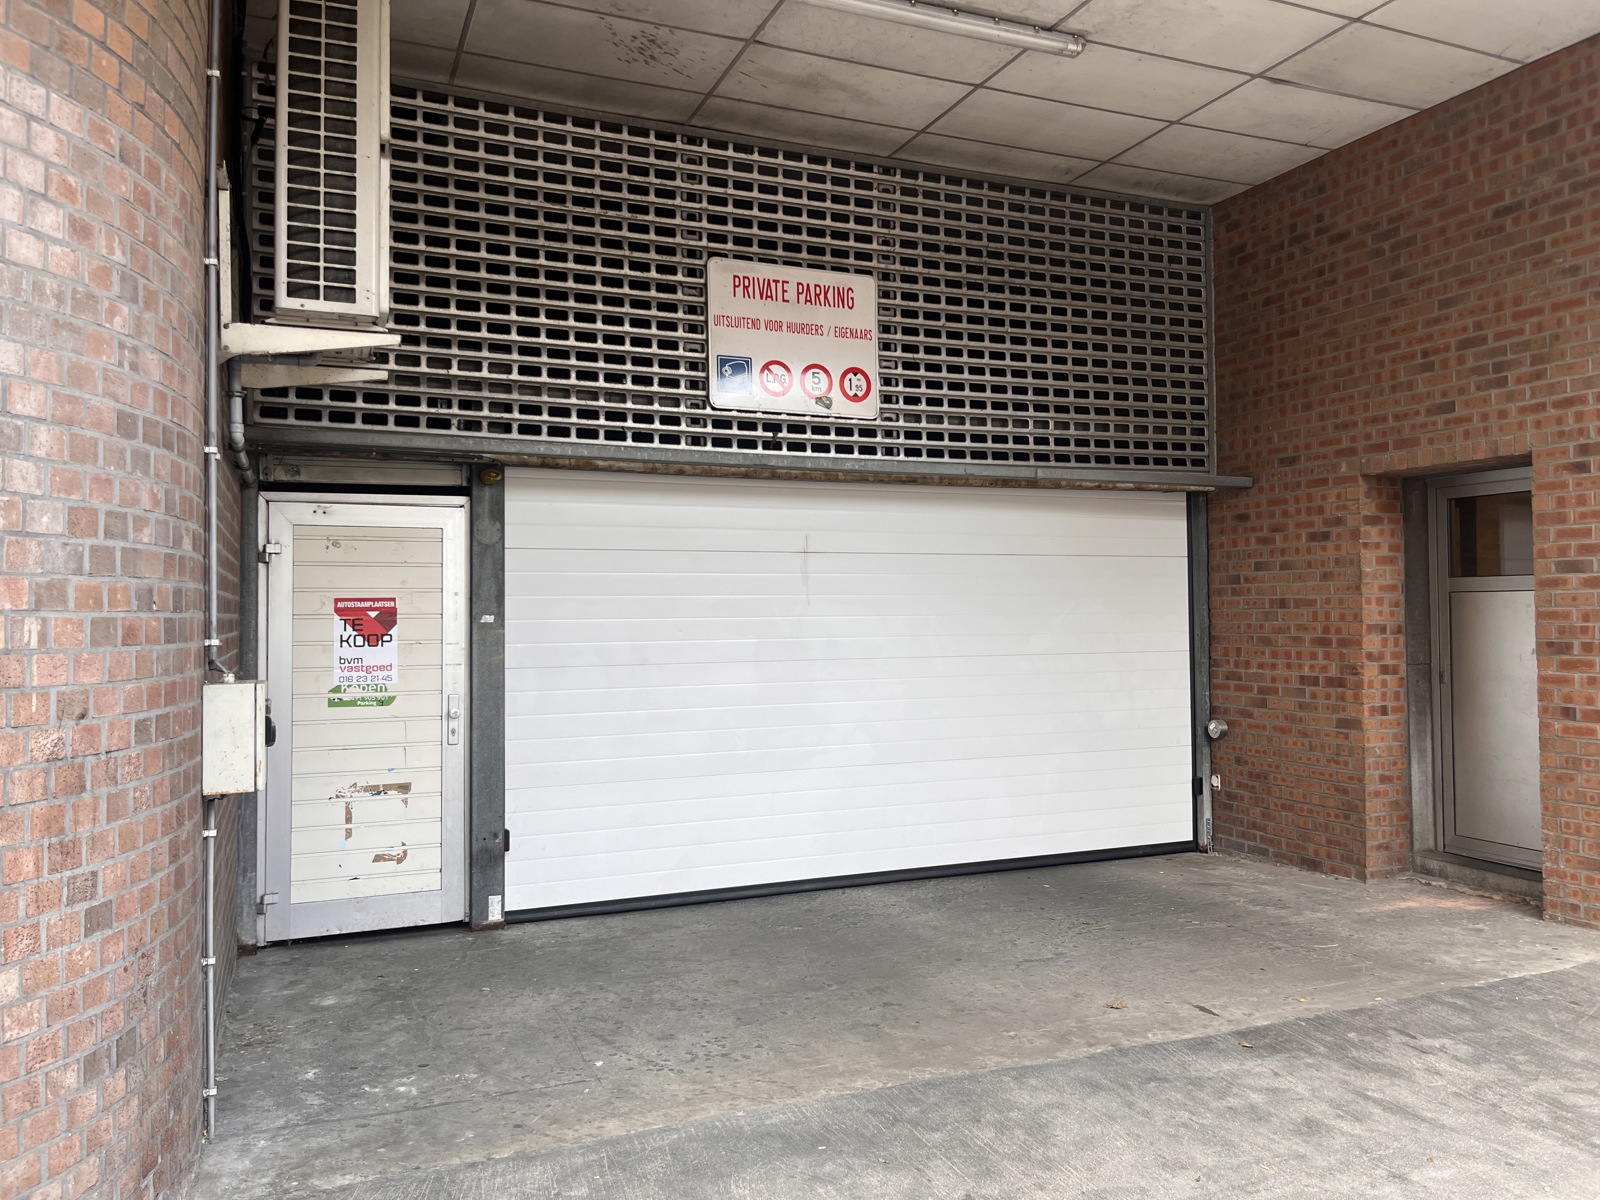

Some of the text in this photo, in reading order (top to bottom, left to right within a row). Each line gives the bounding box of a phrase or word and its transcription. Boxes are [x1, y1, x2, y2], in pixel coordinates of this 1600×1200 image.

[732, 274, 855, 310] PRIVATE PARKING
[713, 314, 873, 341] UITSLUITEND VOOR HUURDERS / EIGENAARS
[811, 371, 821, 386] 5
[848, 377, 852, 391] 1
[339, 618, 364, 632] TE
[340, 633, 393, 648] KOOP
[339, 656, 363, 665] bvm
[339, 663, 393, 674] vastgoed
[356, 675, 368, 683] 23
